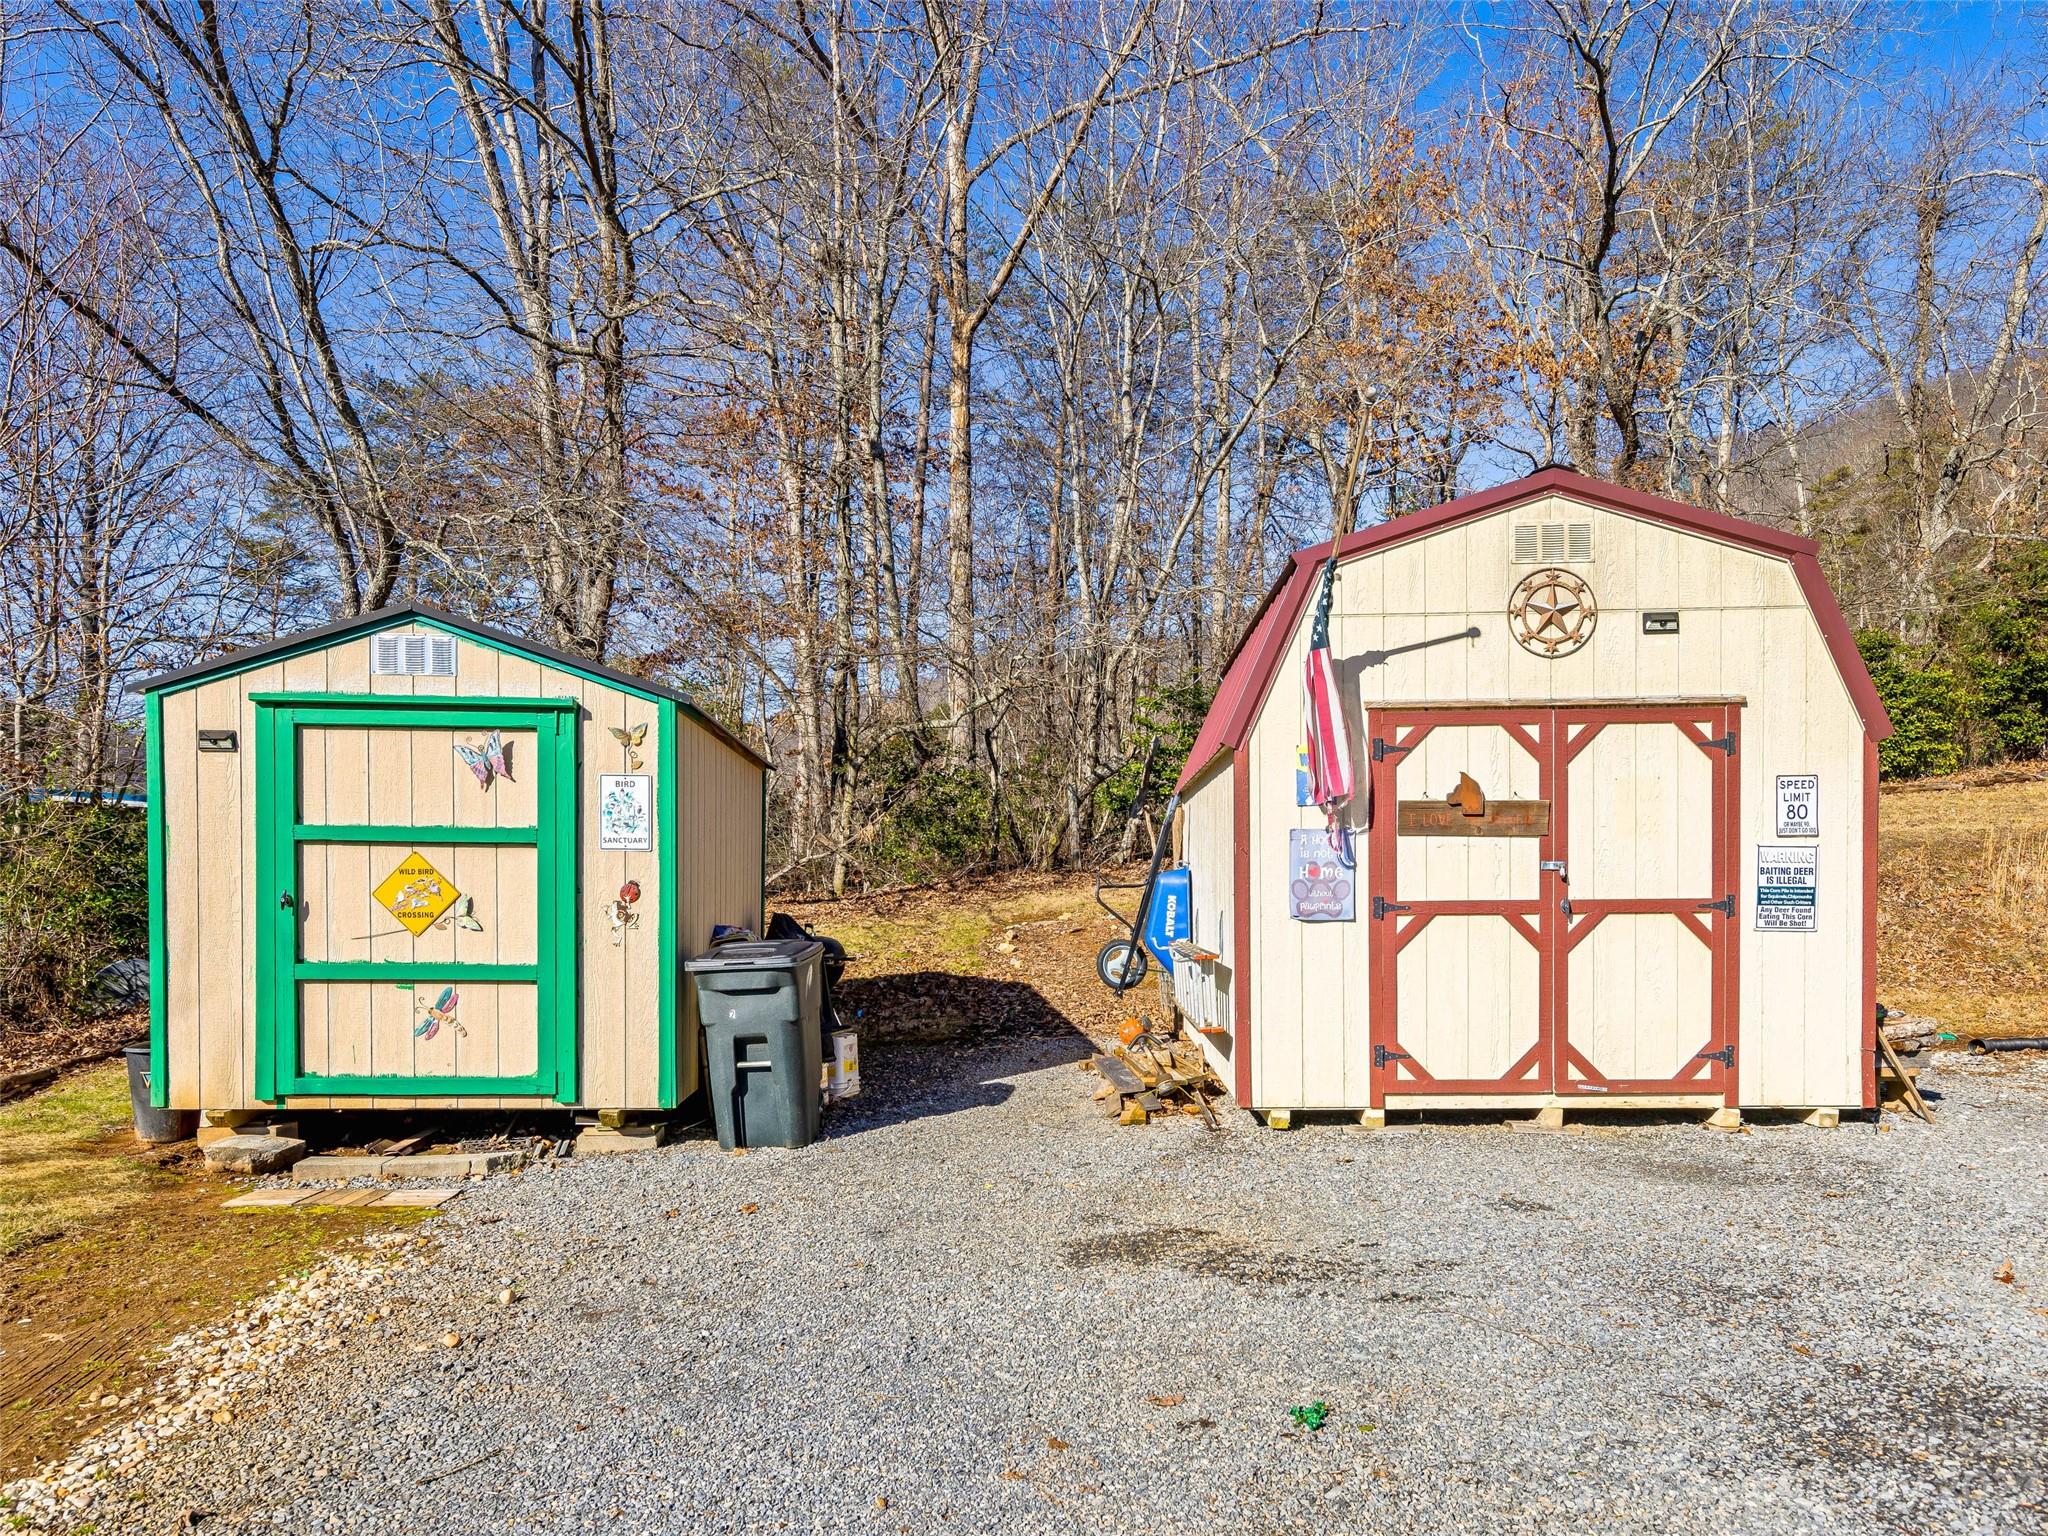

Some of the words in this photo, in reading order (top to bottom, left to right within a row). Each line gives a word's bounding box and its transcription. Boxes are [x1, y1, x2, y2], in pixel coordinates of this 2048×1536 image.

[615, 780, 636, 788] BIRD
[1779, 780, 1815, 790] SPEED
[1783, 792, 1811, 802] LIMIT
[1787, 804, 1808, 820] 80
[602, 836, 648, 844] SANCTUARY
[1300, 846, 1310, 858] is
[1313, 847, 1334, 858] not
[1760, 850, 1814, 863] WARNING
[1760, 867, 1791, 876] BAITING
[1794, 867, 1814, 876] DEER
[1767, 876, 1774, 884] IS
[1776, 876, 1807, 884] ILLEGAL
[1165, 895, 1177, 938] KOBALT
